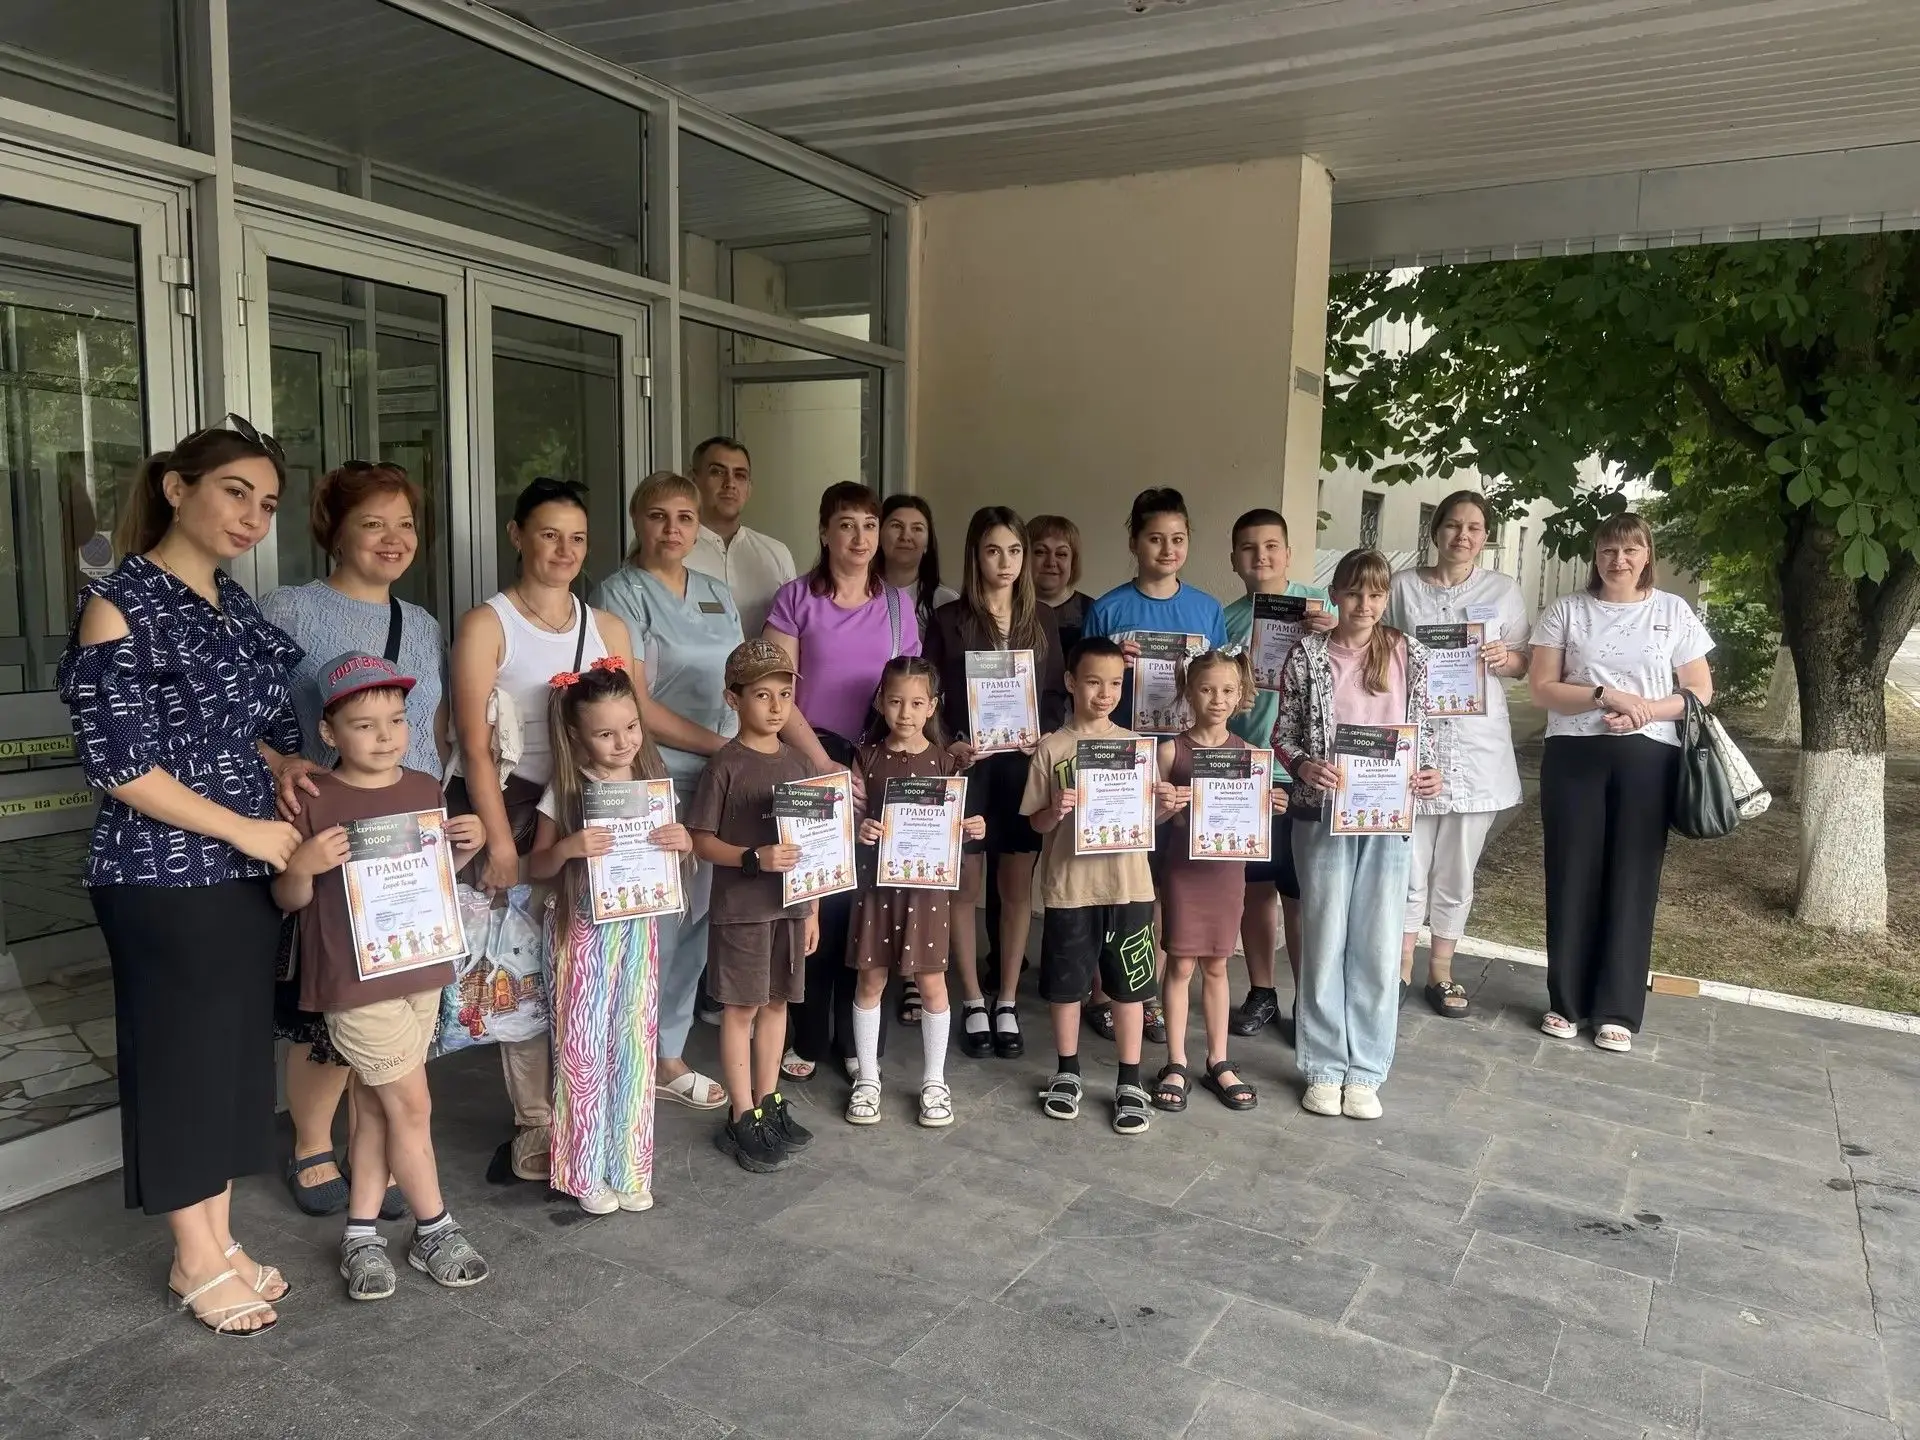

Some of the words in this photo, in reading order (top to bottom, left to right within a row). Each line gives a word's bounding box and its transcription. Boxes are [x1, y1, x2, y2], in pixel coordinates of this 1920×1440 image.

[981, 681, 1021, 689] ГРАМОТА
[27, 736, 70, 752] здесь!
[1352, 739, 1375, 747] 1000₽
[1353, 759, 1402, 767] ГРАМОТА
[1093, 772, 1138, 782] ГРАМОТА
[1208, 781, 1255, 790] ГРАМОТА
[34, 799, 51, 809] на
[59, 791, 93, 806] себя!
[791, 799, 813, 807] 1000₽
[899, 808, 946, 817] ГРАМОТА
[357, 823, 399, 833] СЕРТИФИКАТ
[363, 835, 392, 846] 1000₽
[366, 857, 430, 878] ГРАМОТА
